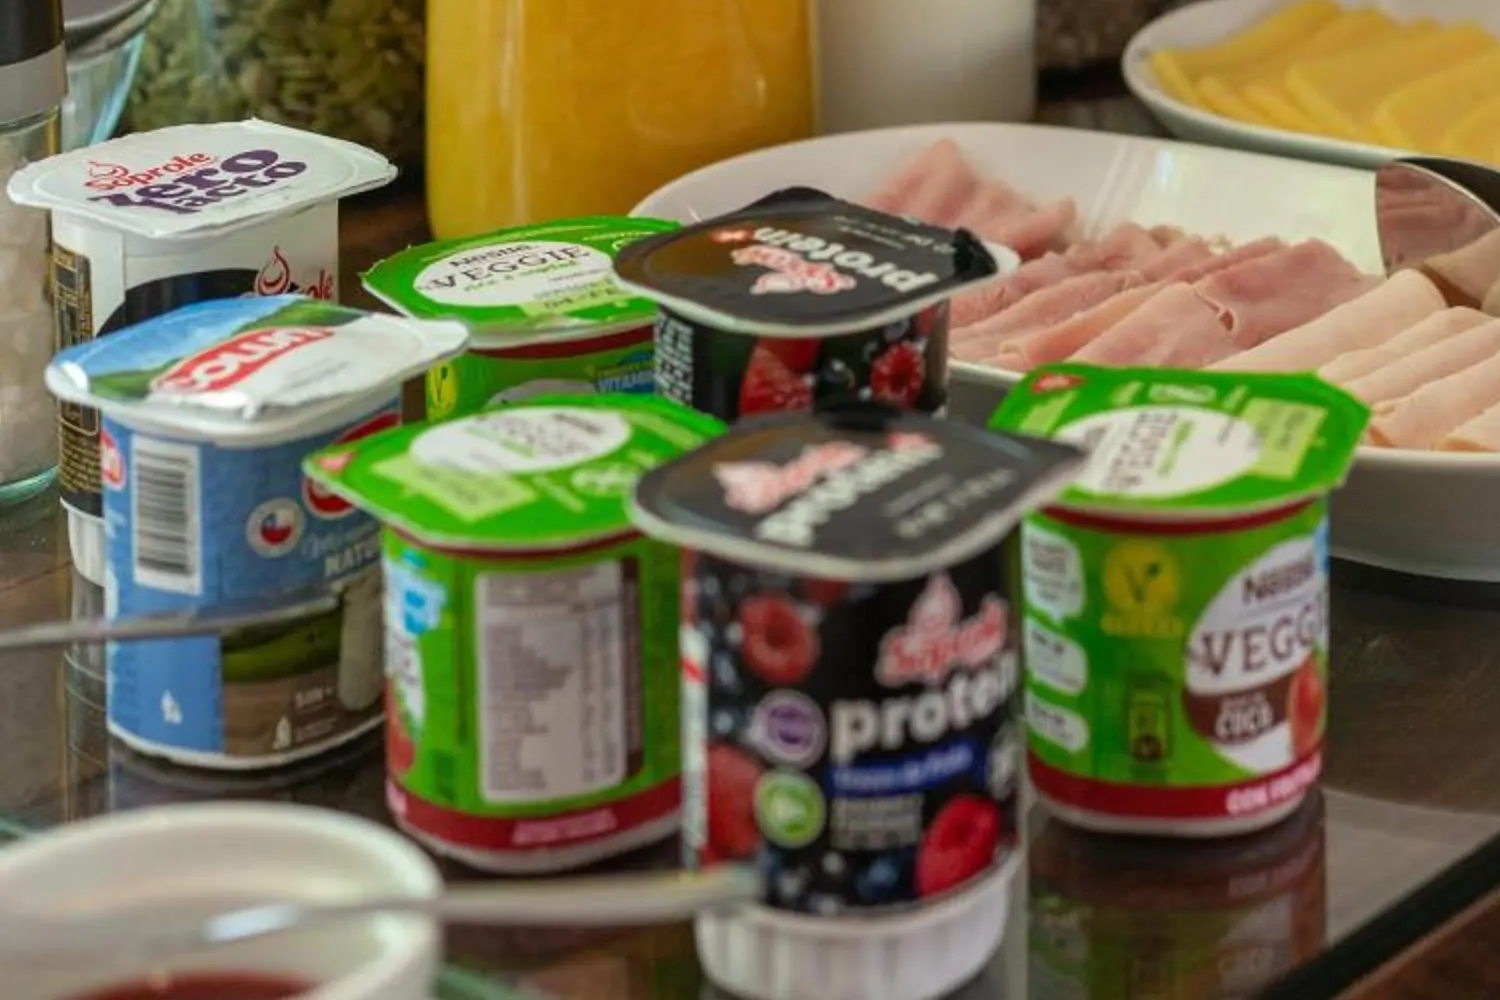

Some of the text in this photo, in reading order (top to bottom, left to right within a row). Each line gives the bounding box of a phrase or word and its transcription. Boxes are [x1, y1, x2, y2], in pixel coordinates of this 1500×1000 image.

[84, 151, 212, 191] Soprole
[87, 149, 280, 206] zero
[142, 160, 308, 215] lacto
[430, 246, 590, 291] VEGGIE
[754, 226, 940, 294] protein
[829, 651, 1019, 766] protei
